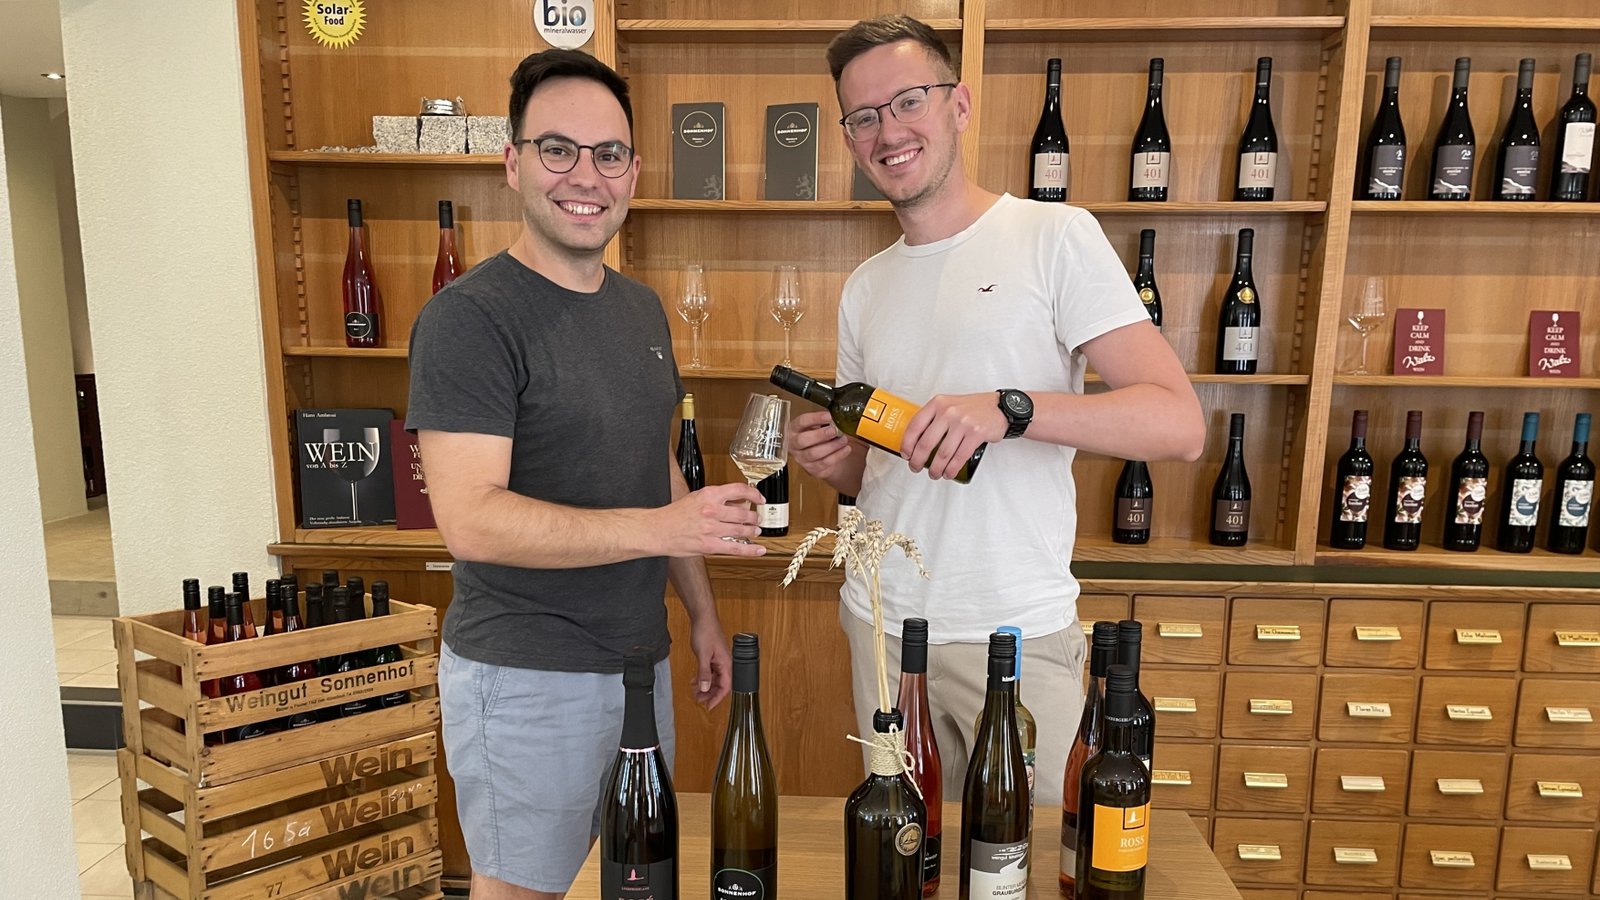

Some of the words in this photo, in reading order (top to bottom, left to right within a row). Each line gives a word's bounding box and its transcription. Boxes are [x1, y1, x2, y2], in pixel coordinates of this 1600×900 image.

[324, 16, 344, 25] Food
[543, 0, 587, 26] bio
[1045, 168, 1063, 179] 401
[1143, 168, 1162, 179] 401
[1250, 168, 1269, 179] 401
[884, 408, 900, 430] ROSS
[304, 442, 376, 463] WEIN
[341, 461, 348, 469] Z
[1127, 513, 1145, 523] 401
[1226, 515, 1244, 525] 401
[225, 683, 308, 714] Weingut
[321, 661, 414, 694] Sonnenhof
[319, 747, 413, 788] Wein
[320, 787, 414, 834] Wein
[1120, 835, 1145, 848] ROSS
[321, 834, 414, 881] Wein
[337, 863, 424, 900] Wein
[266, 881, 283, 899] 77
[717, 886, 757, 897] SONNENHOF
